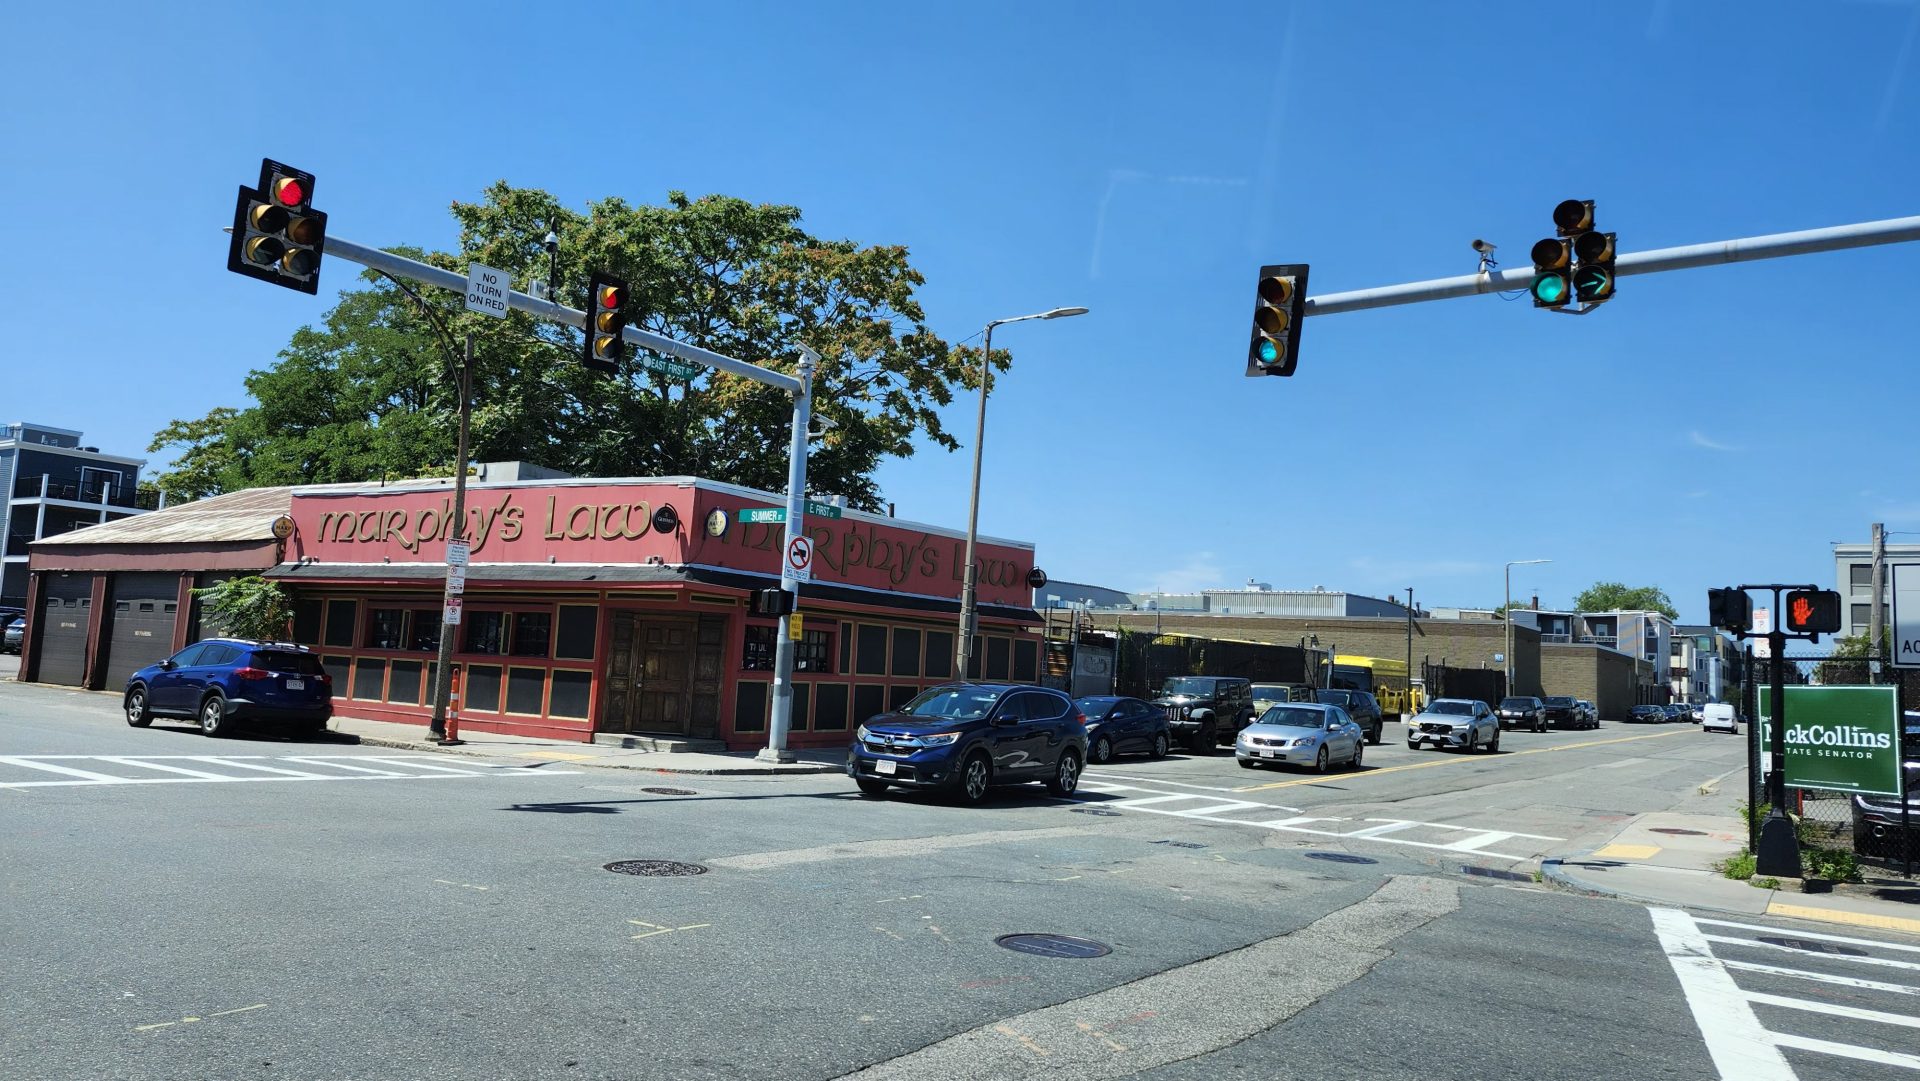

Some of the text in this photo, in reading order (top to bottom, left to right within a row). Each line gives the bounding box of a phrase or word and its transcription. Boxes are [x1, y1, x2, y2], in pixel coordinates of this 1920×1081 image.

[482, 273, 497, 285] NO
[475, 283, 502, 298] TURN
[469, 294, 505, 311] ON RED
[651, 358, 667, 371] EAST
[668, 363, 686, 376] FIRST
[545, 495, 652, 542] Law
[751, 510, 777, 521] SUMMER
[816, 505, 830, 517] FIRST
[1764, 723, 1891, 749] ckCollins
[1785, 747, 1873, 759] TATE SENATOR
